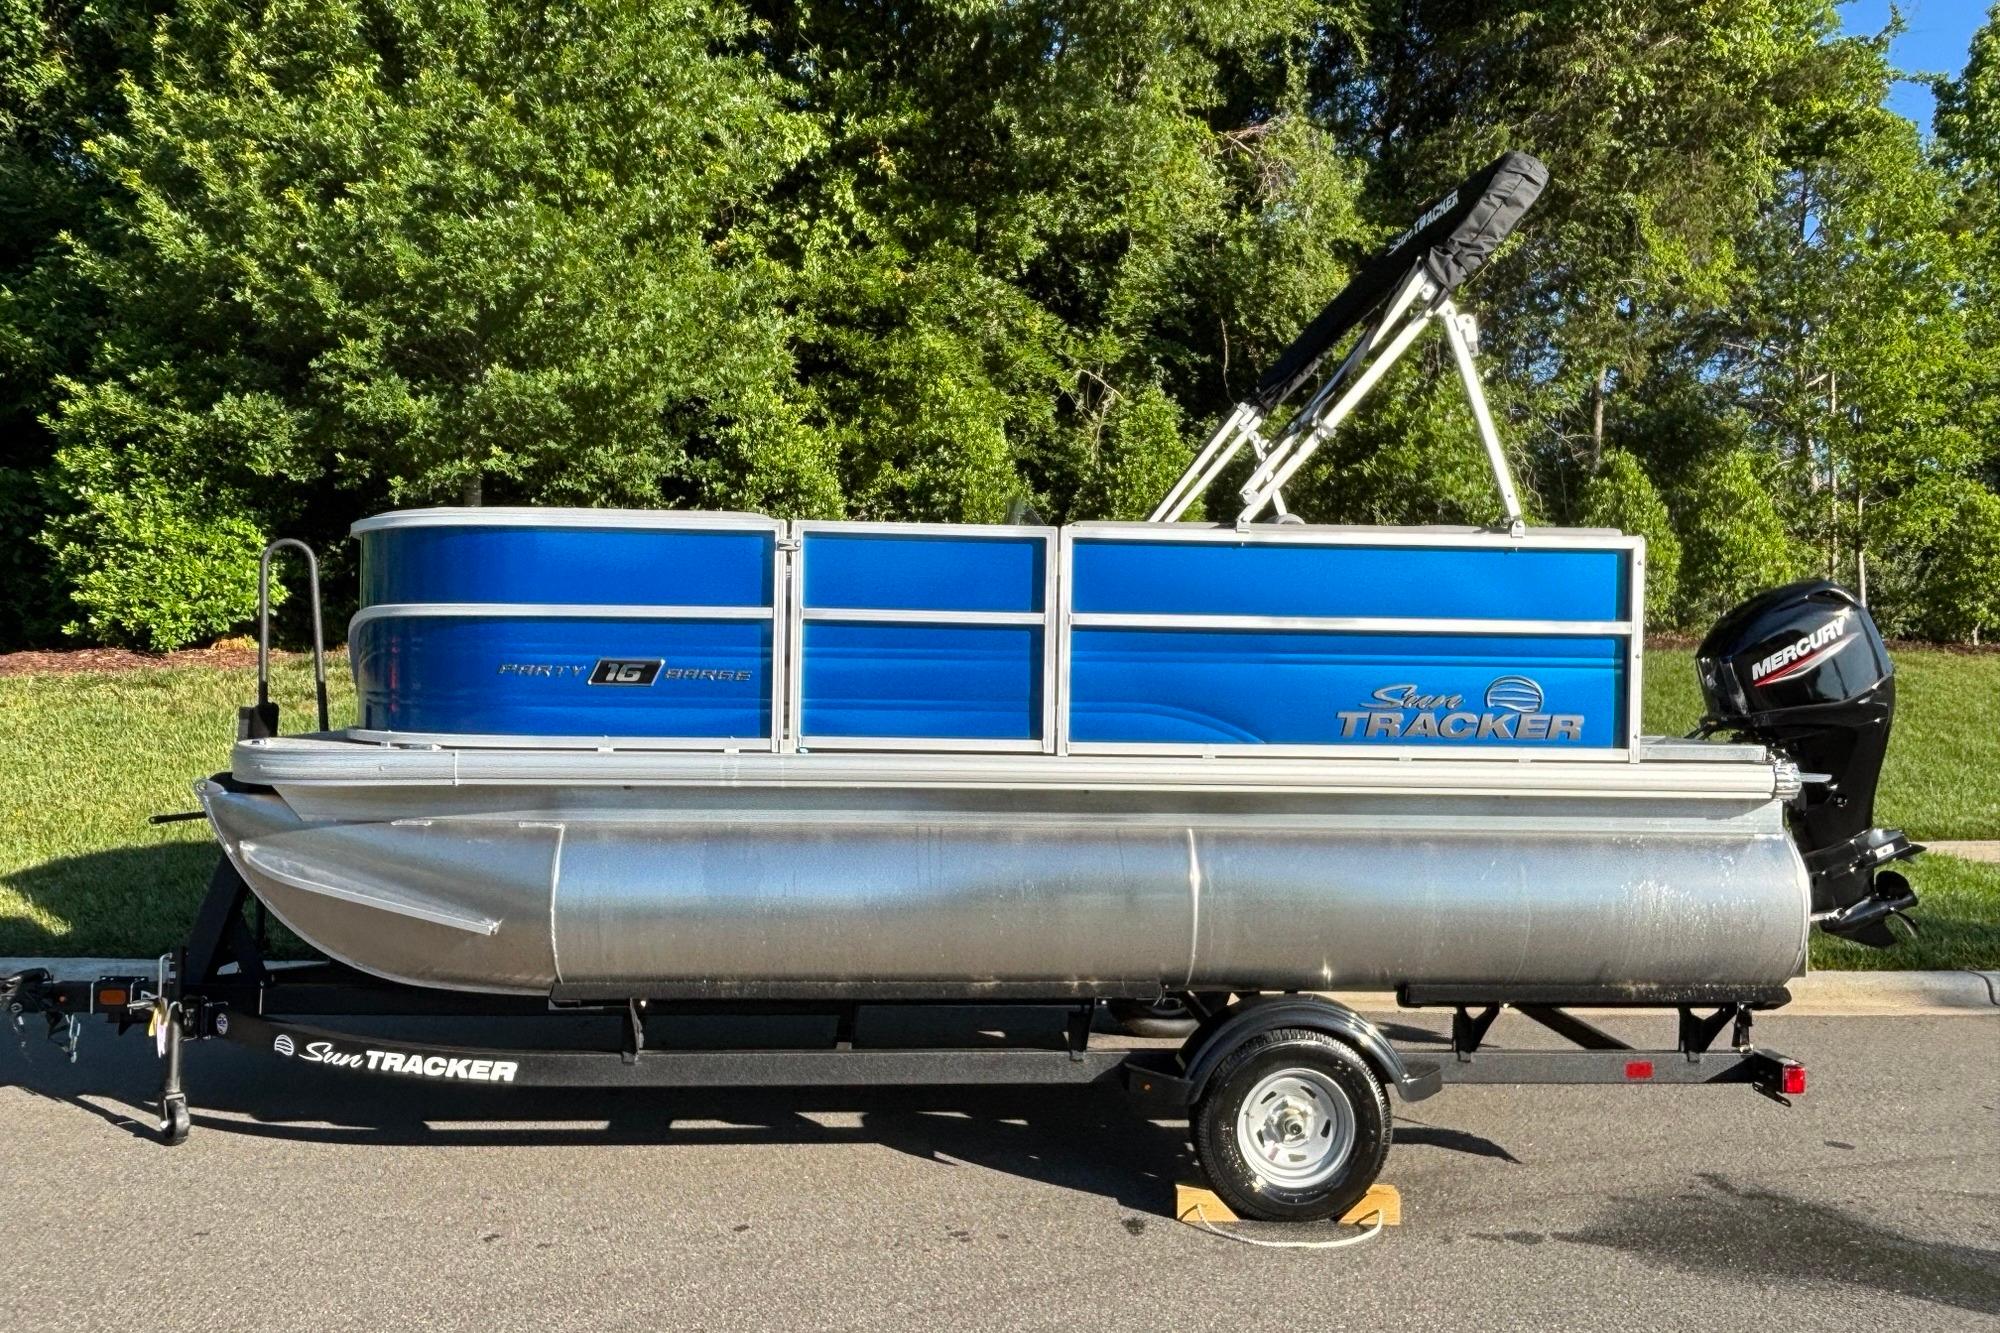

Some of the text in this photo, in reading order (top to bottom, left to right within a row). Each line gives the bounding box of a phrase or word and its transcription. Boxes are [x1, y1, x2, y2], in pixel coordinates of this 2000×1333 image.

[1414, 189, 1458, 234] TRACKER
[1752, 615, 1846, 680] MERCURY
[497, 663, 753, 682] PARTY 16 BARGE
[1360, 683, 1465, 709] Sun
[1336, 711, 1585, 740] TRACKER
[299, 1042, 518, 1082] Sun TRACKER
